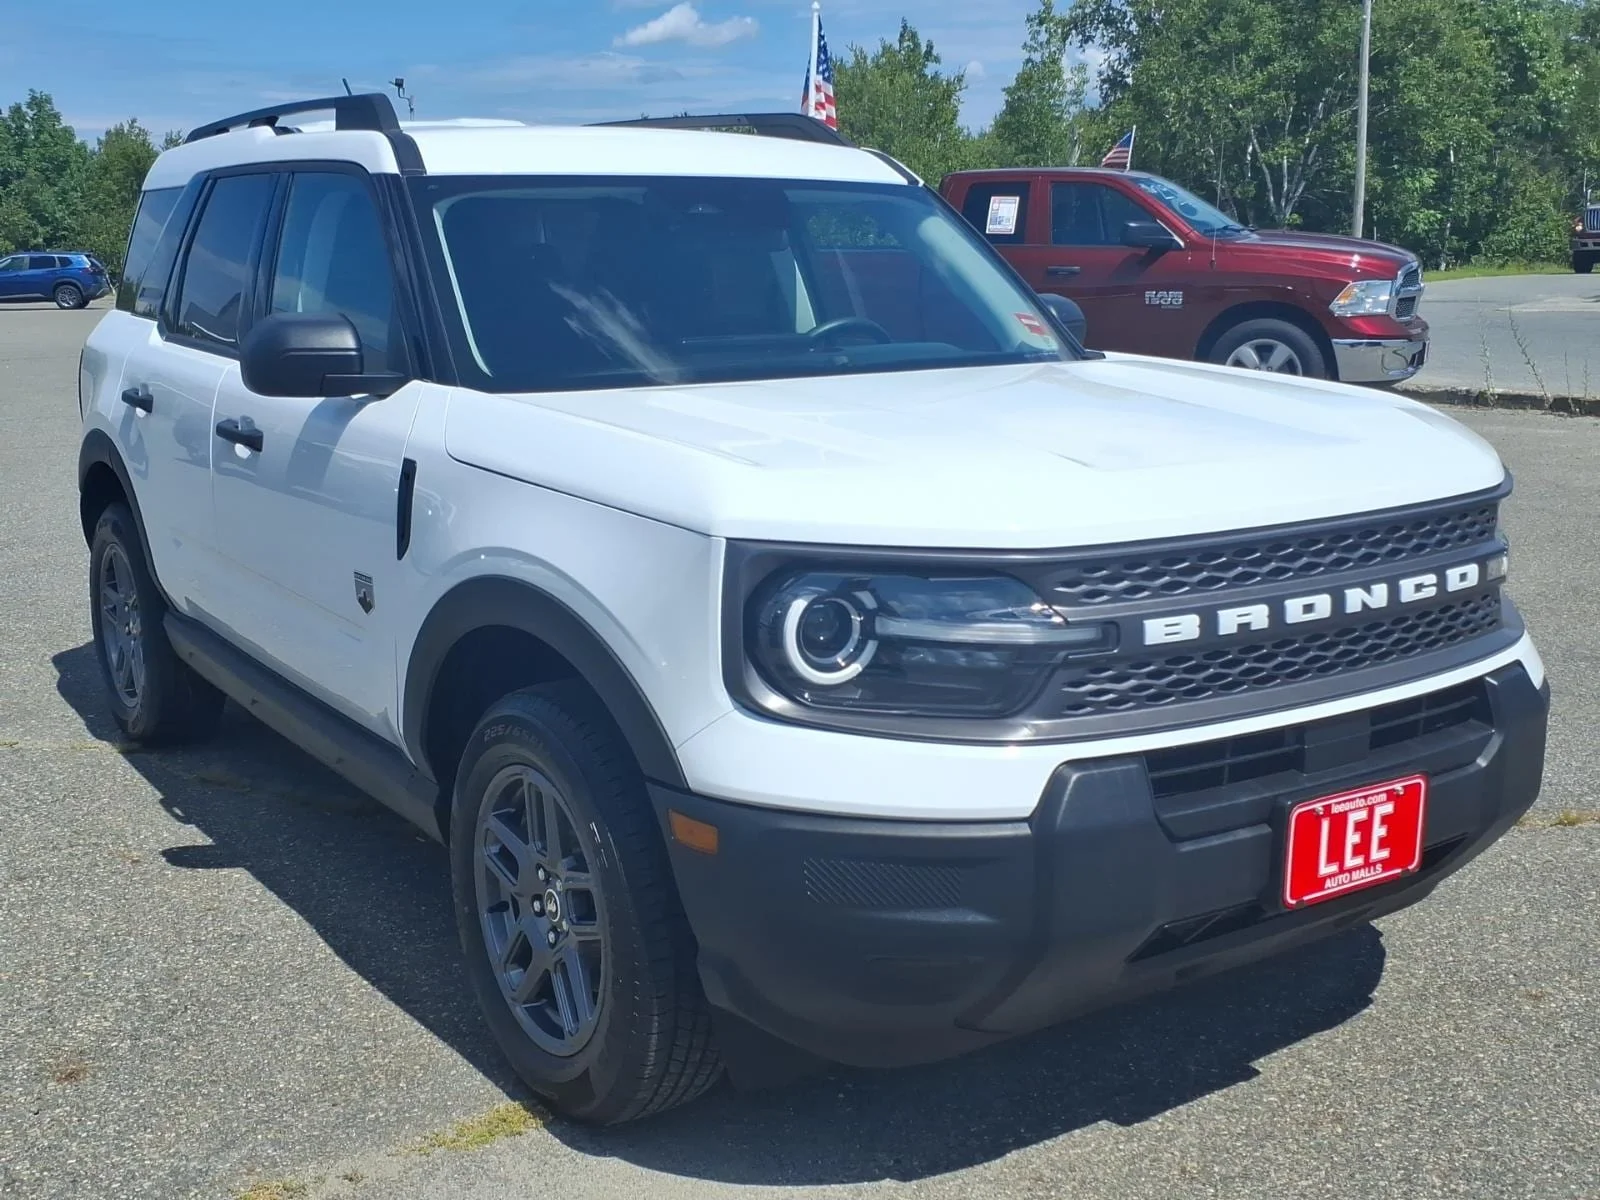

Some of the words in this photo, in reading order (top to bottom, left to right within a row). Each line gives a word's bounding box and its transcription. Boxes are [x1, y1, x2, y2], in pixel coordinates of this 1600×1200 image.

[1143, 563, 1479, 646] BRONCO
[1331, 792, 1387, 814] leeauto.com
[1318, 802, 1394, 876] LEE
[1324, 873, 1350, 889] AUTO
[1351, 863, 1383, 881] MALLS
